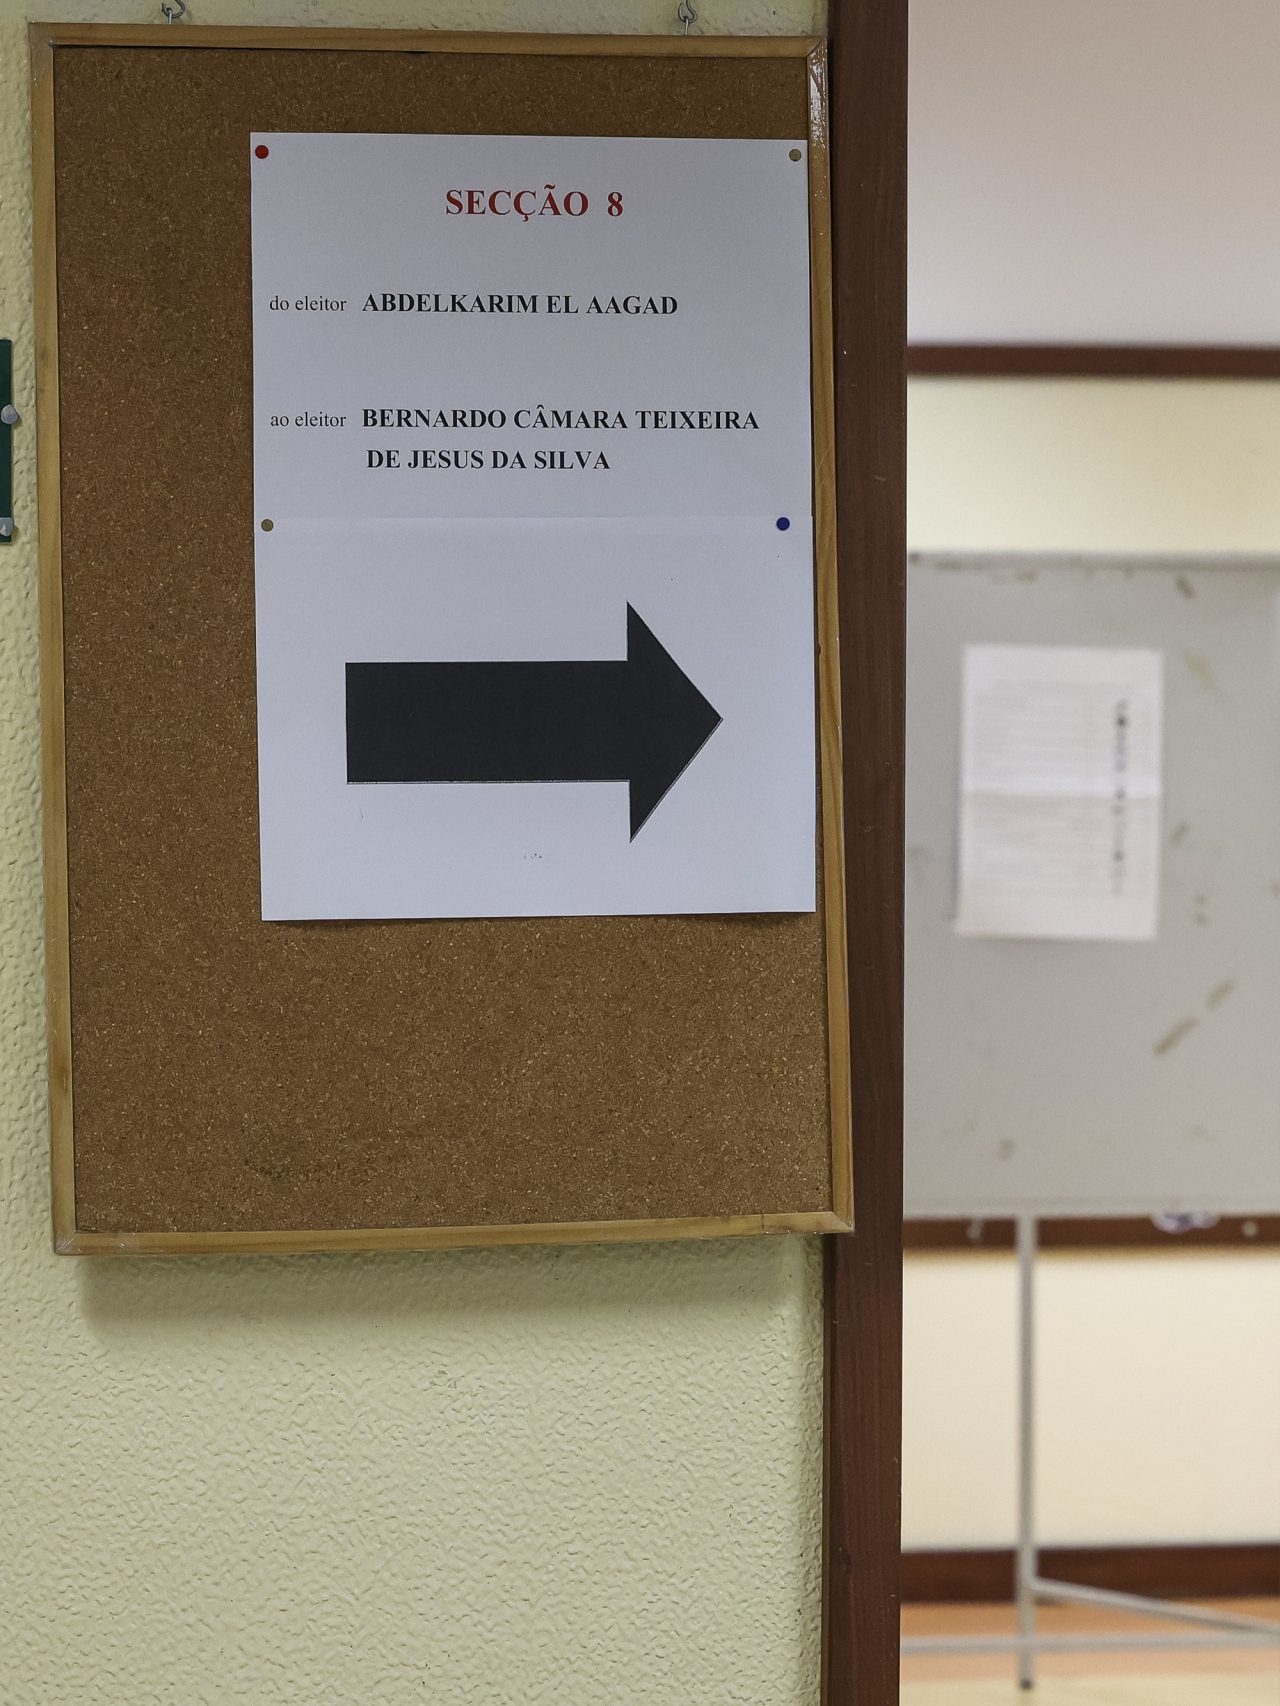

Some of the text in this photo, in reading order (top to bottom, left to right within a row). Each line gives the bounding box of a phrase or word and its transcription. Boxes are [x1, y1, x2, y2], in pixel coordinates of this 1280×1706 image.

[445, 184, 624, 222] SECÇÃO 8
[269, 293, 679, 315] do eleitor ABDELKARIM EL AAGAD
[269, 404, 760, 431] ao eleitor BERNARDO CÂMARA TEIXEIRA
[366, 449, 611, 470] DE JESUS DA SILVA
